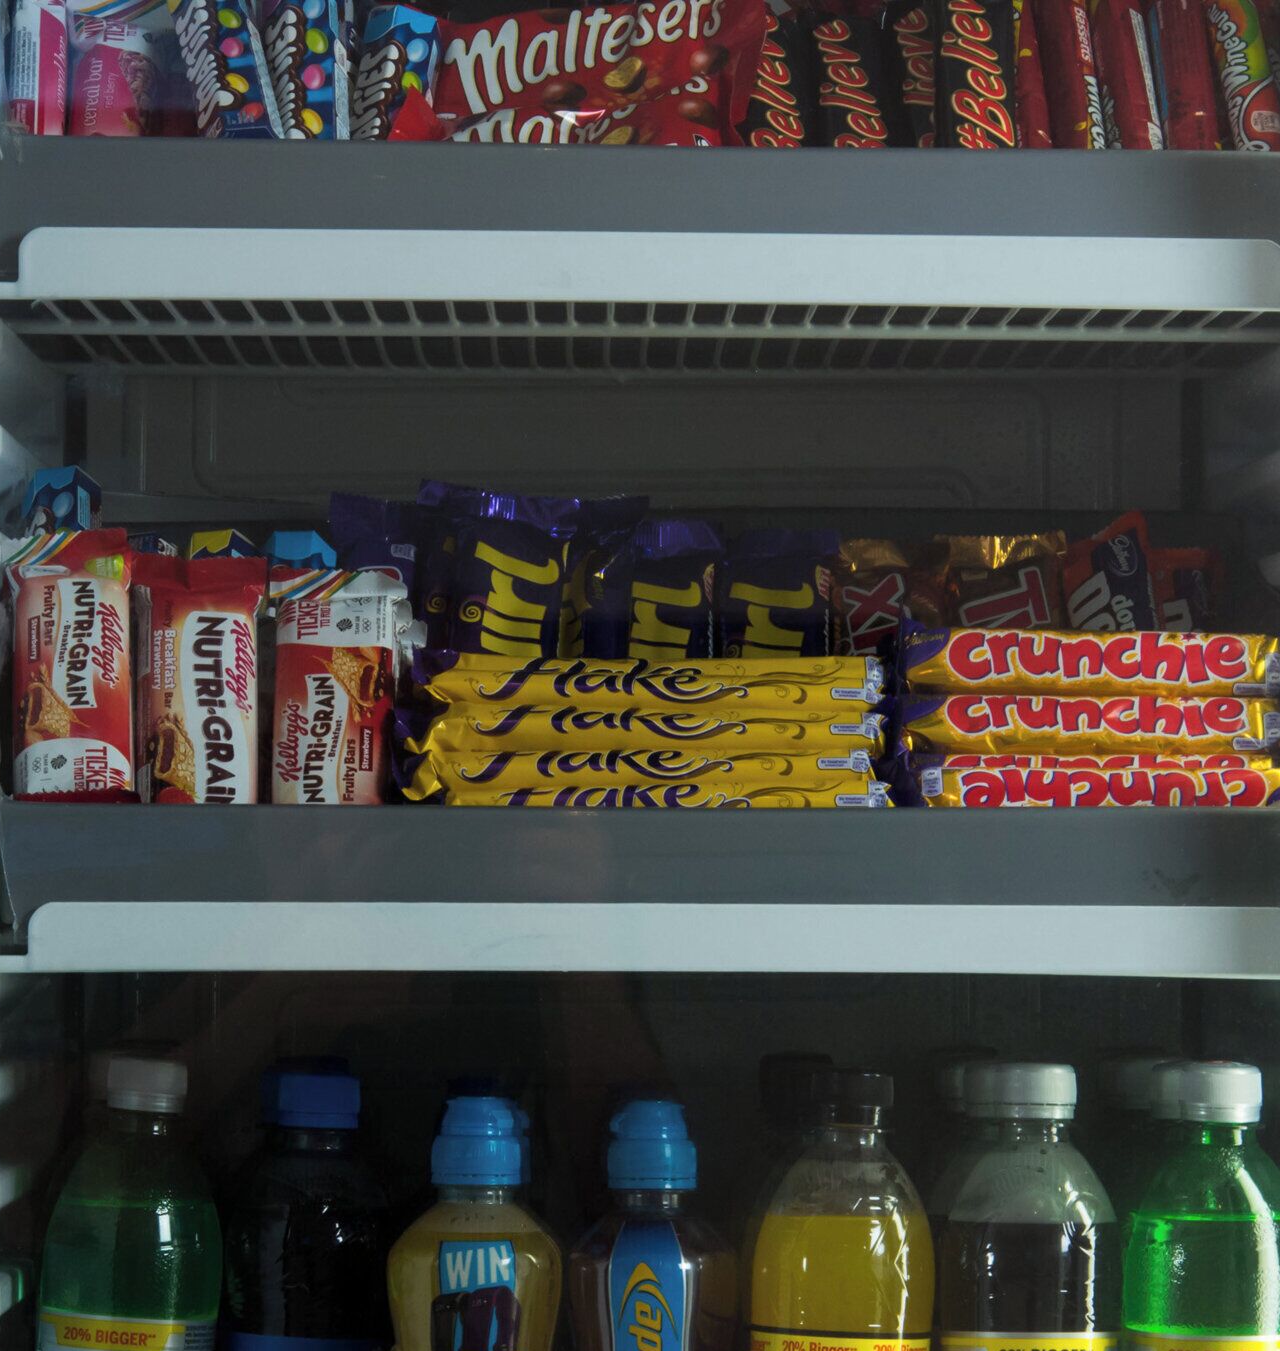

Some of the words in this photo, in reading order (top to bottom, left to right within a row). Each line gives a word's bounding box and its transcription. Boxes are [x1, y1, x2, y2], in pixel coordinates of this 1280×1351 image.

[444, 0, 724, 114] Maltesers
[42, 584, 56, 619] Fruity
[28, 617, 40, 661] Strawberry
[43, 619, 55, 647] Bars
[57, 624, 71, 664] Breakfast
[91, 601, 125, 688] Kellogg's
[151, 629, 163, 691] Strawberry
[163, 629, 177, 689] Breakfast
[225, 619, 256, 714] Kellogg's
[275, 702, 309, 784] Kellogg's
[327, 719, 342, 757] Breakfast
[344, 738, 356, 765] Bars
[362, 728, 372, 770] Strawberry
[343, 765, 358, 802] Fruity
[446, 1246, 510, 1289] WIN
[63, 1326, 92, 1342] 20%
